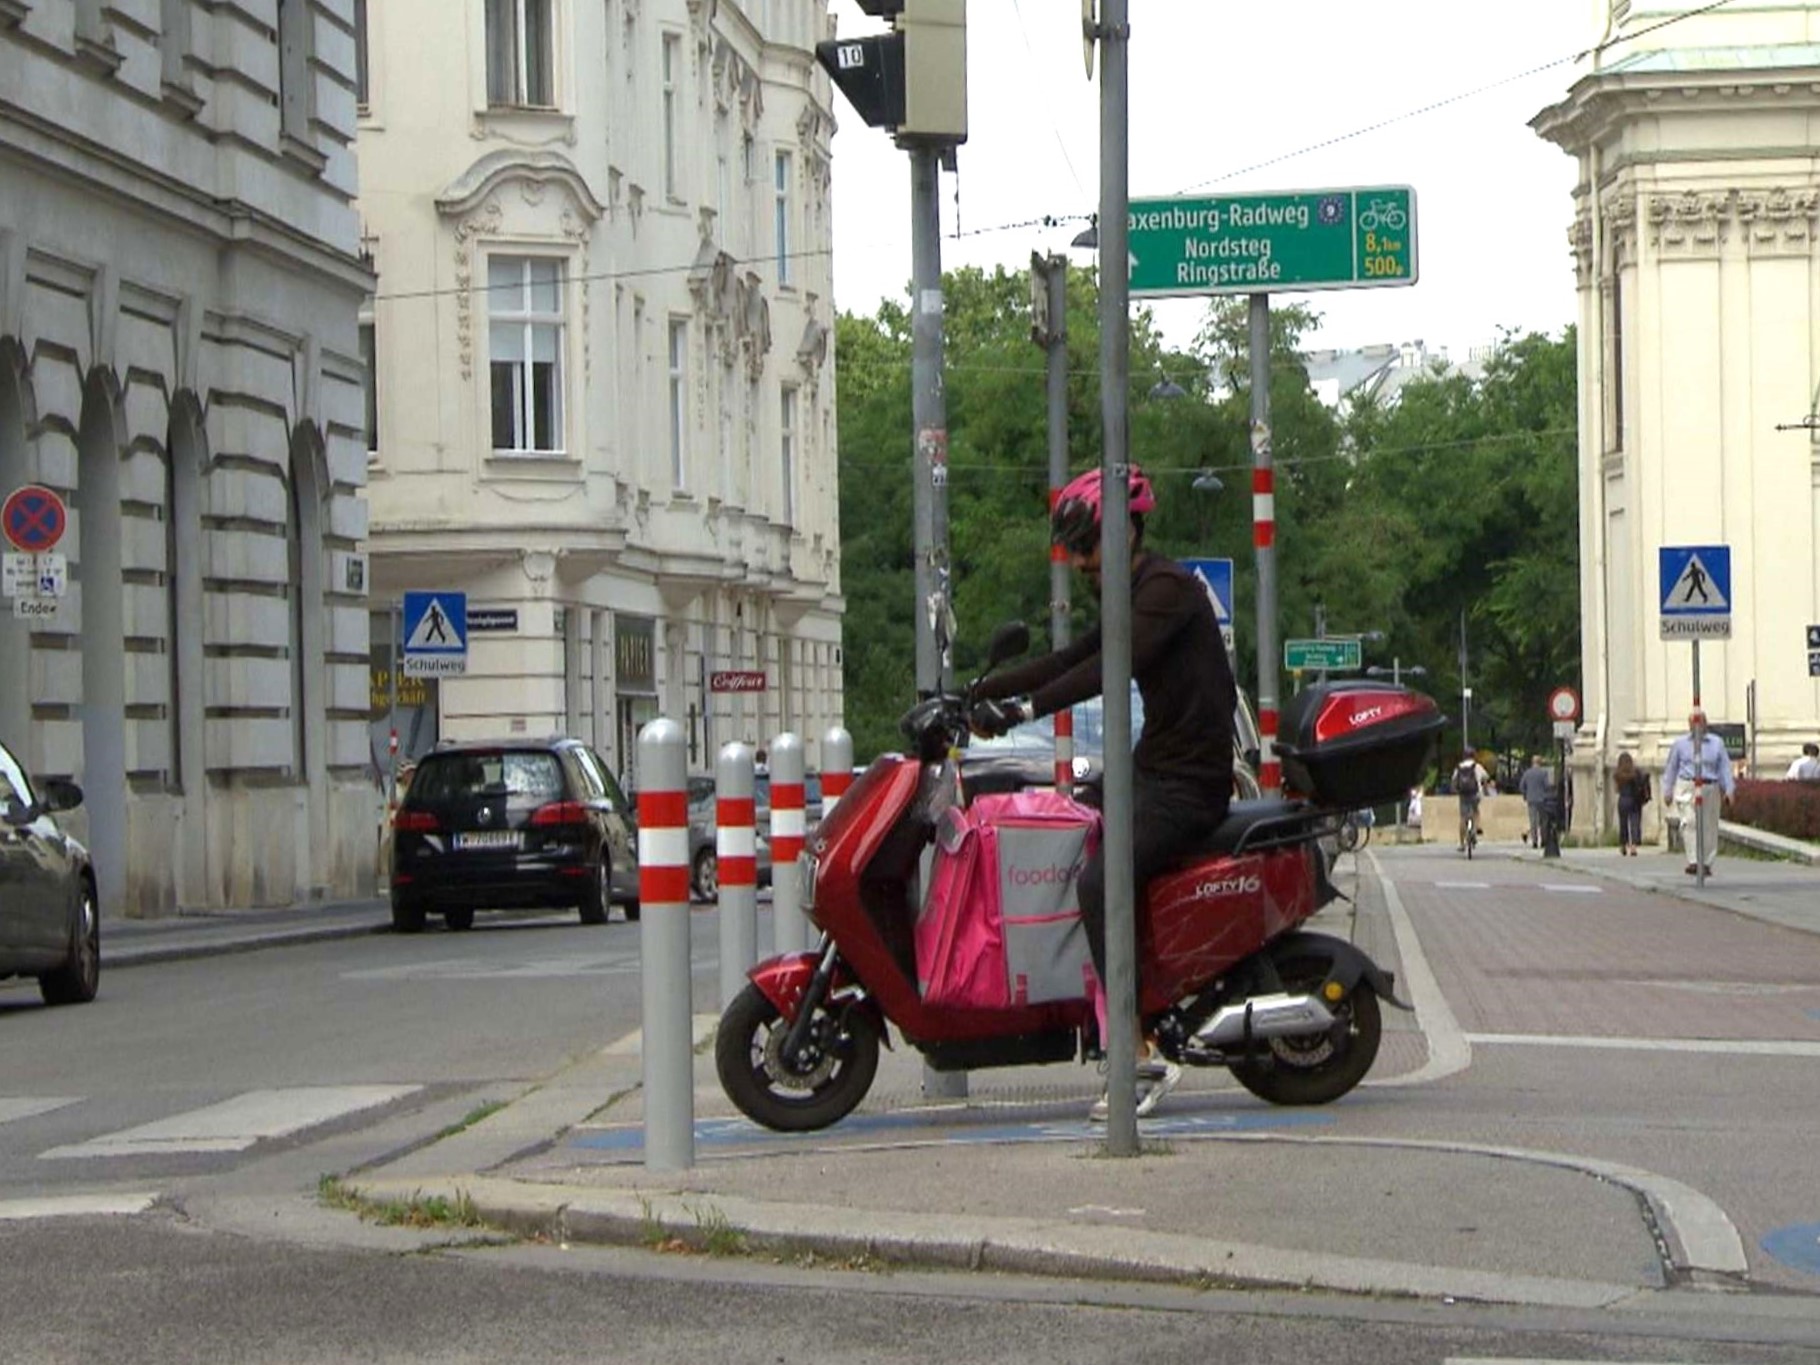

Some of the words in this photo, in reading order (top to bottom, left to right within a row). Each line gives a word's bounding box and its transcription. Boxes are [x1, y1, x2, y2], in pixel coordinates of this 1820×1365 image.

[842, 46, 861, 65] 10
[1128, 203, 1309, 232] axenburg-Radweg
[1185, 237, 1271, 258] Nordsteg
[1177, 258, 1281, 285] Ringstraße
[1662, 620, 1730, 634] Schulweg
[406, 657, 466, 673] Schulweg
[1349, 706, 1382, 726] LOFTY
